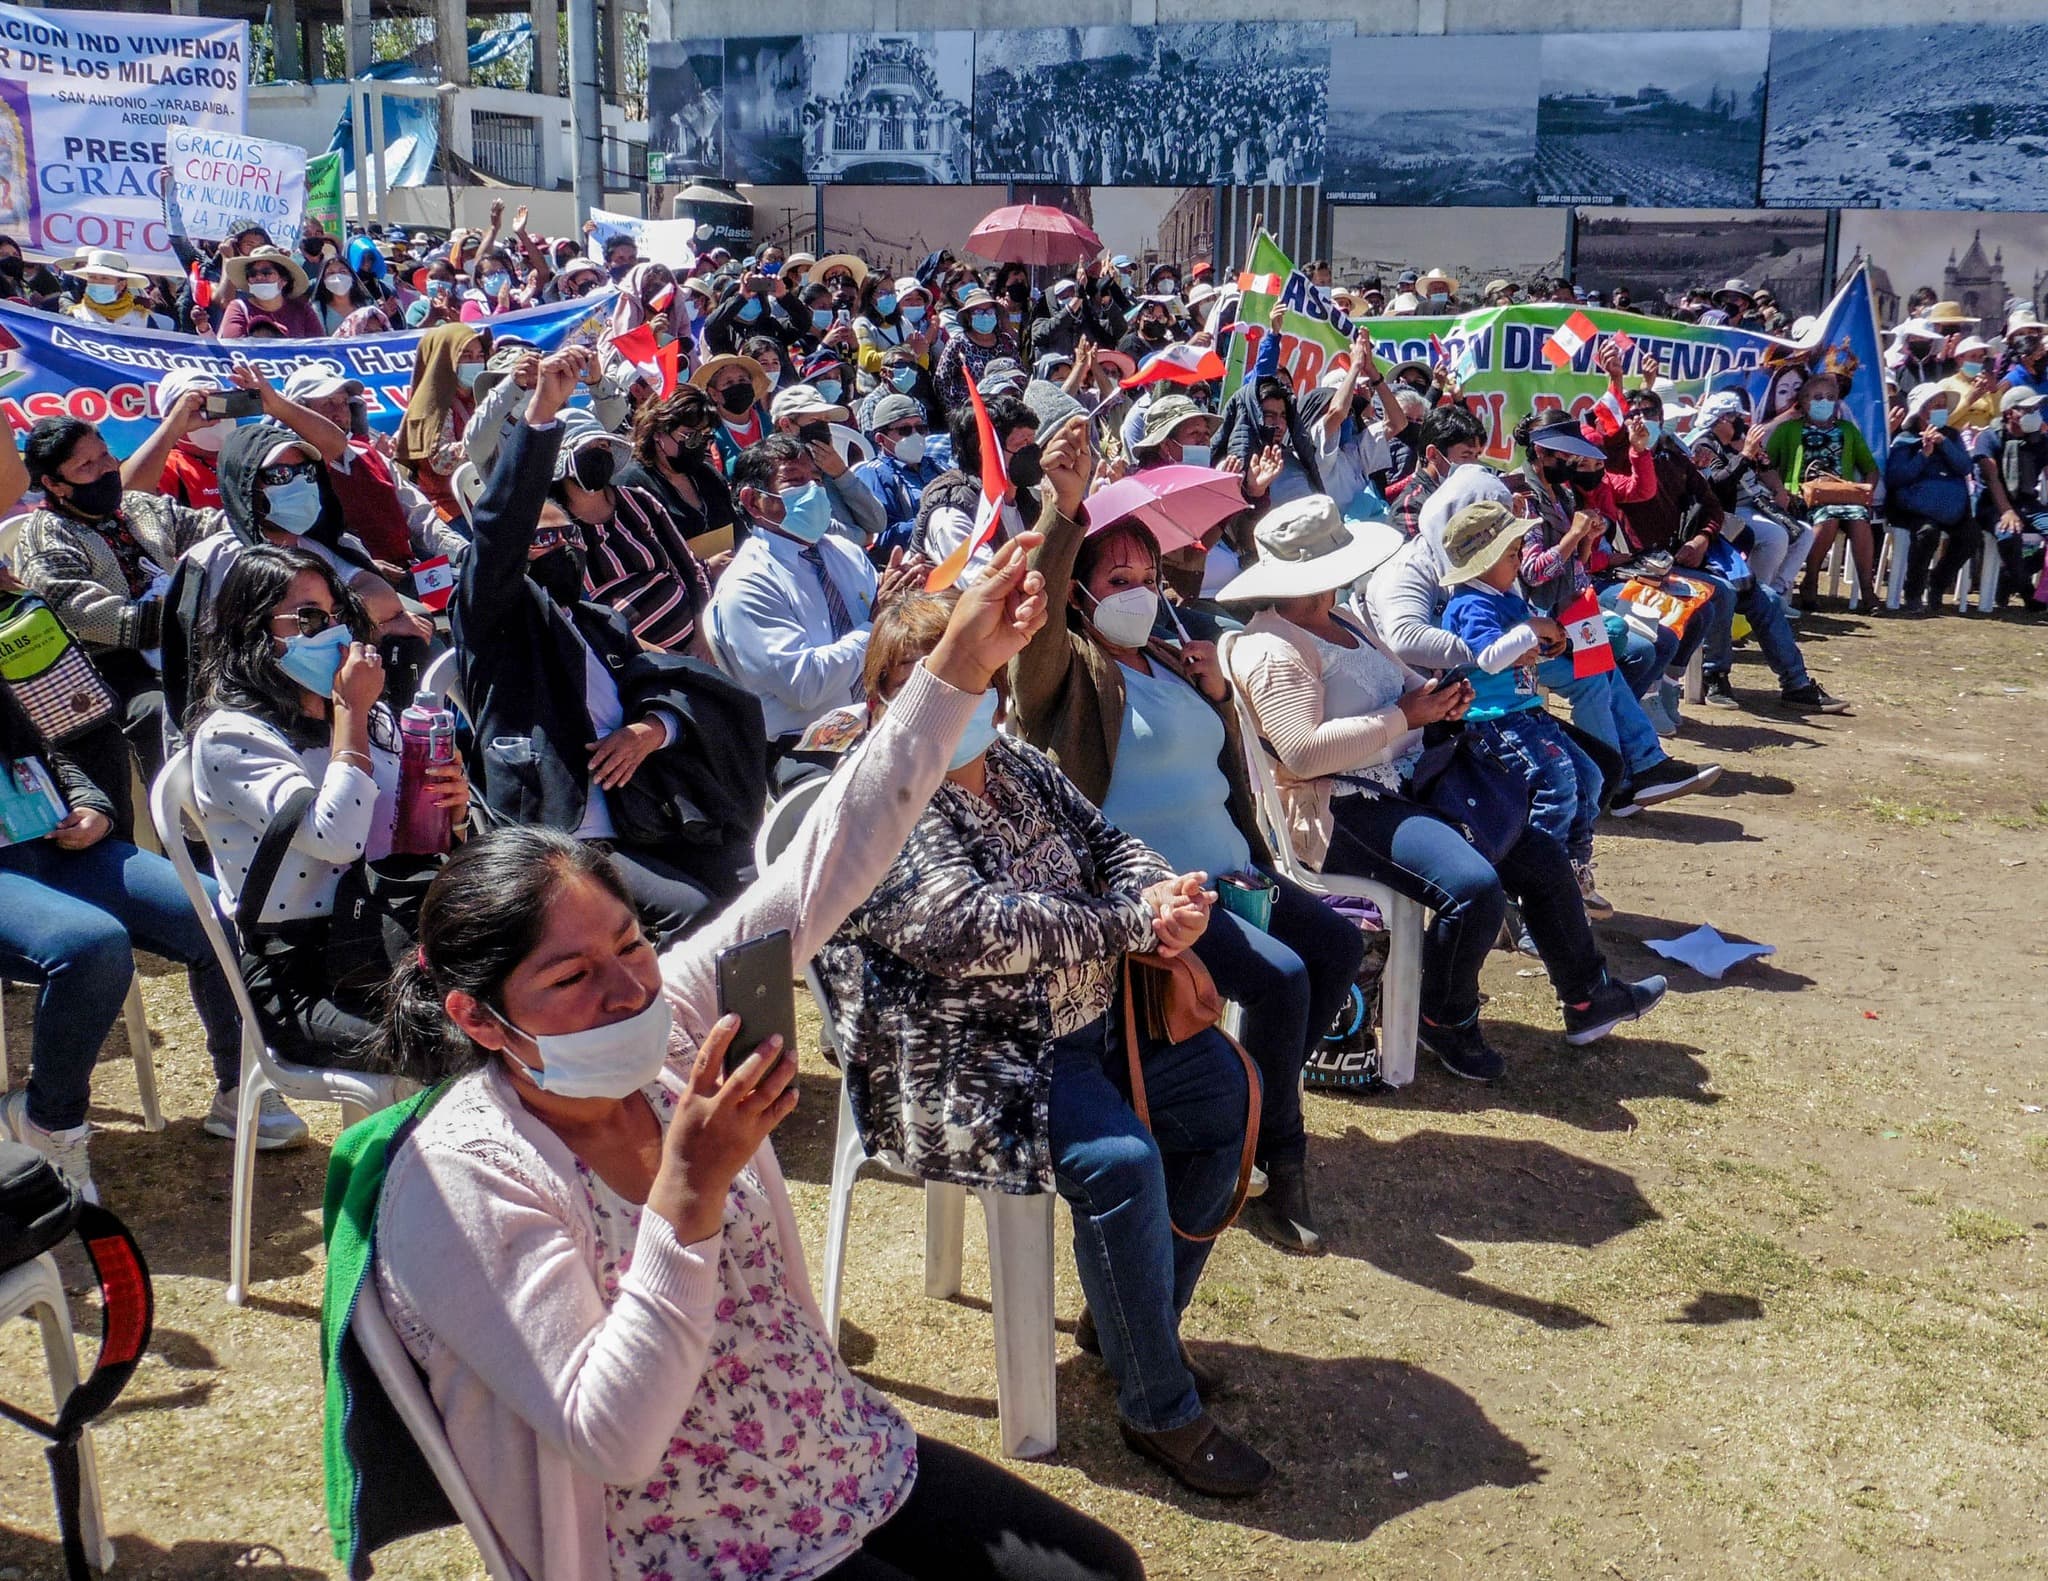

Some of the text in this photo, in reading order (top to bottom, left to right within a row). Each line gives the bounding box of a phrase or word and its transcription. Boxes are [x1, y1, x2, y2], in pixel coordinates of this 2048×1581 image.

[76, 32, 120, 54] IND
[127, 36, 241, 63] VIVIENDA
[20, 49, 54, 74] DE
[61, 56, 110, 80] LOS
[118, 60, 237, 91] MILAGROS
[88, 94, 147, 110] ANTONIO
[121, 112, 188, 126] AREQUIPA
[176, 133, 262, 165] GRACIAS
[185, 158, 282, 195] COFOPRI
[170, 182, 196, 202] POR
[193, 208, 208, 226] LA
[1504, 323, 1554, 372] DE
[14, 634, 31, 648] us
